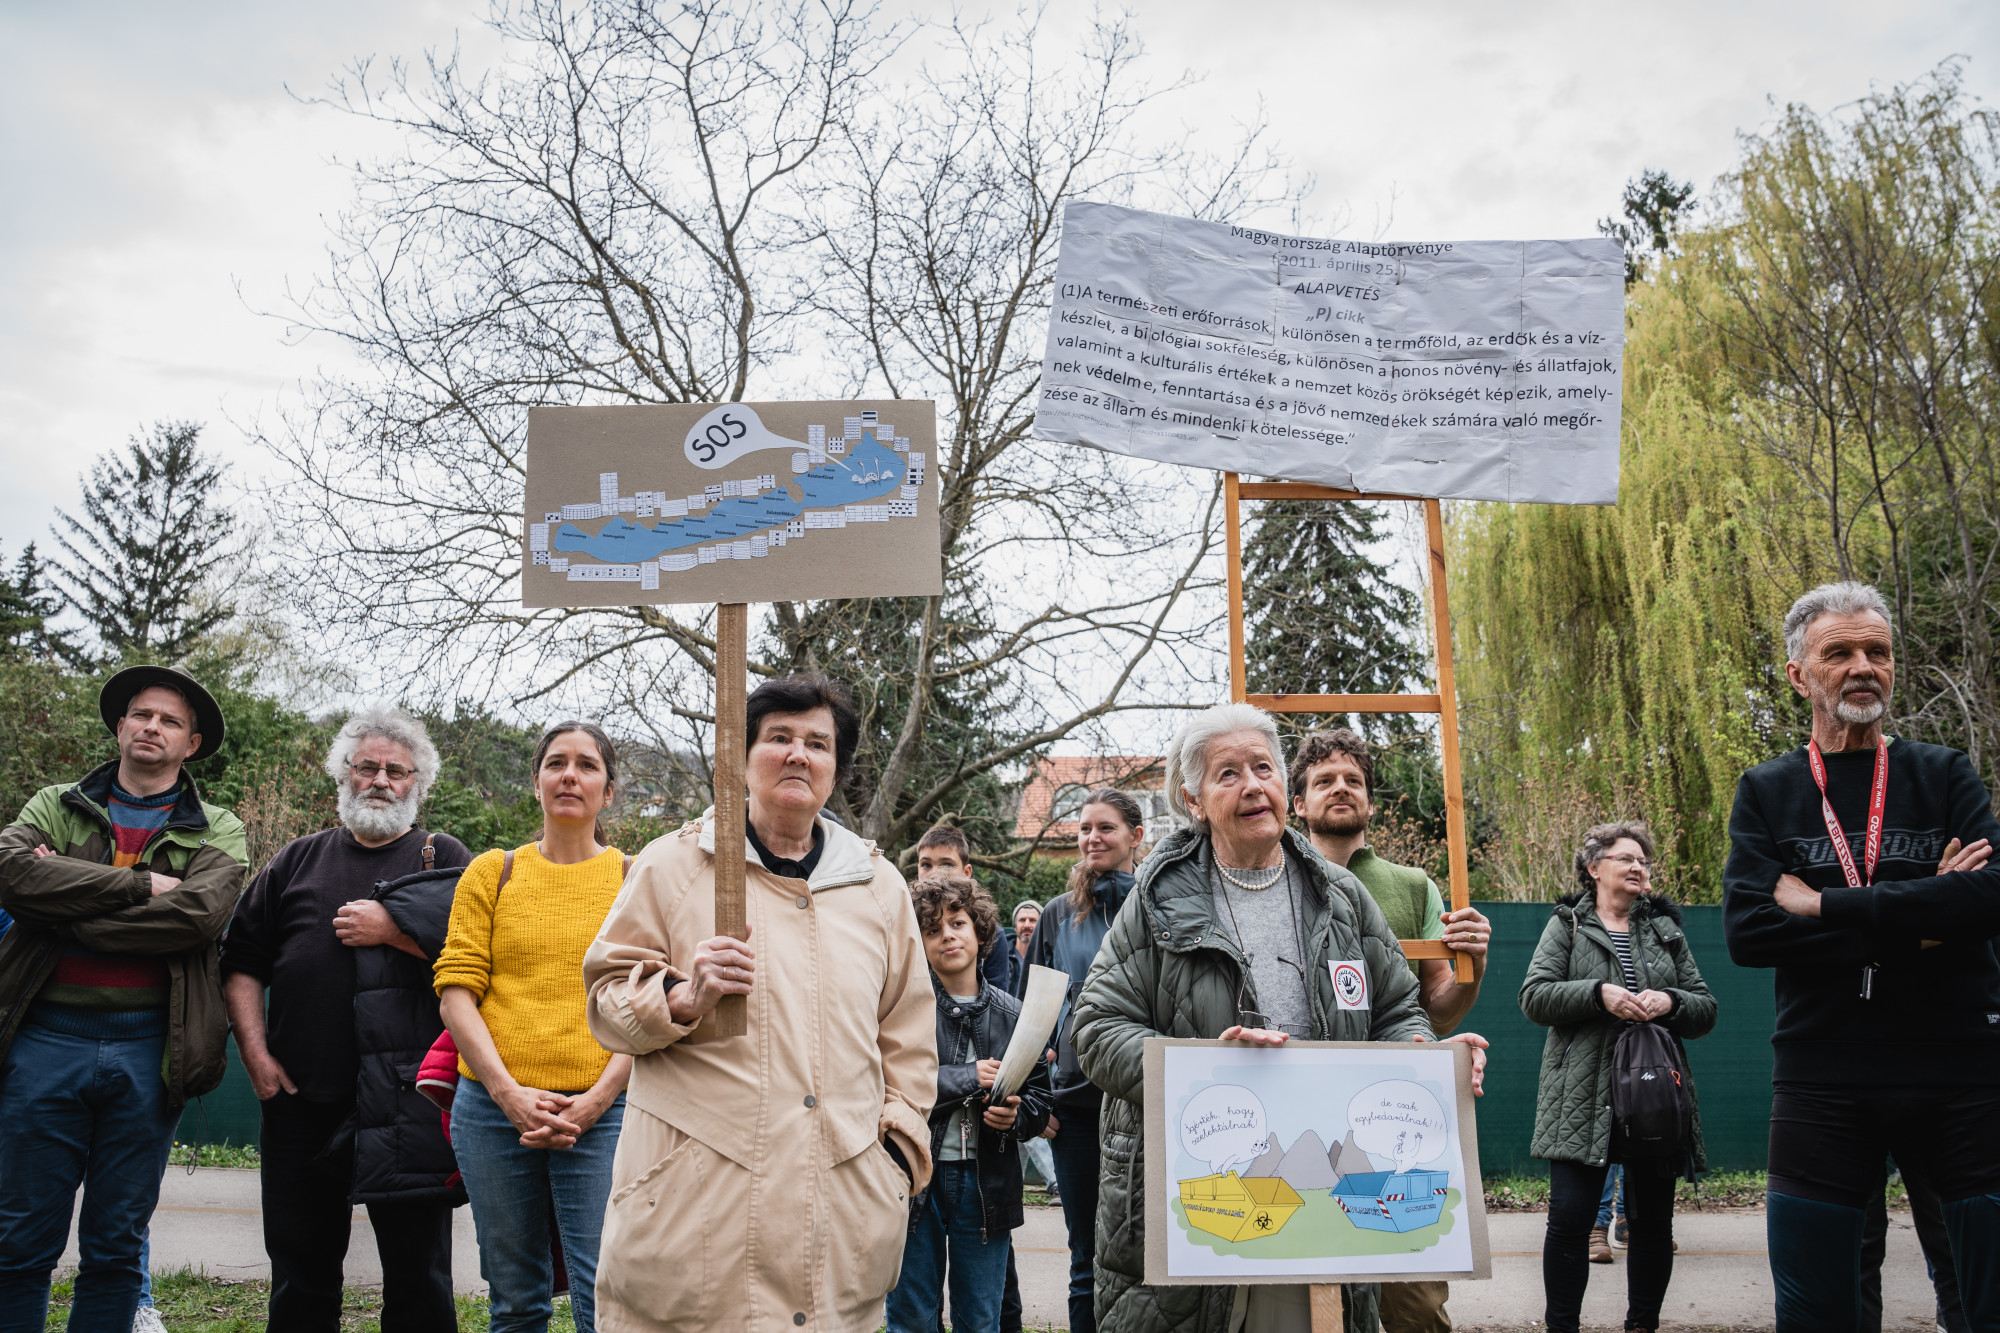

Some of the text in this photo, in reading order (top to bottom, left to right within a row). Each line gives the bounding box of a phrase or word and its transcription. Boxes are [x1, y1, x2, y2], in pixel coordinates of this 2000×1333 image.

[1272, 253, 1407, 278] (2011. április 25.)
[1345, 242, 1453, 257] Alaptörvénye
[1294, 282, 1380, 301] ALAPVETÉS
[1096, 290, 1178, 317] természeti
[1182, 309, 1272, 336] erőforrások,
[1282, 326, 1359, 343] különösen
[1365, 337, 1372, 347] a
[1377, 336, 1461, 350] termőföld,
[1466, 336, 1483, 346] az
[1488, 332, 1537, 346] erdők
[1542, 332, 1559, 344] és
[1564, 334, 1573, 344] a
[1579, 332, 1606, 344] víz-
[1336, 309, 1366, 324] cikk
[1061, 310, 1617, 381] készlet, a biológiai sokféleség, különösen a honos növény- és állatfajok,
[1057, 336, 1613, 406] valamint a kulturális értékek a nemzet közös örökségét képezik, amely-
[1044, 388, 1077, 402] zése
[1083, 395, 1099, 407] az
[1103, 397, 1145, 417] állam
[1151, 409, 1168, 421] és
[1172, 411, 1245, 433] mindenki
[1053, 360, 1602, 430] nek védelme, fenntartása és a jövő nemzedékek számára való megőr-
[691, 412, 748, 463] SOS
[1874, 743, 1886, 808] www.blizzard-ski.com
[1867, 815, 1880, 877] BLIZZARD
[1227, 1106, 1255, 1118] hogy
[1380, 1098, 1418, 1112] de csak
[1191, 1119, 1258, 1145] szelektálnak!
